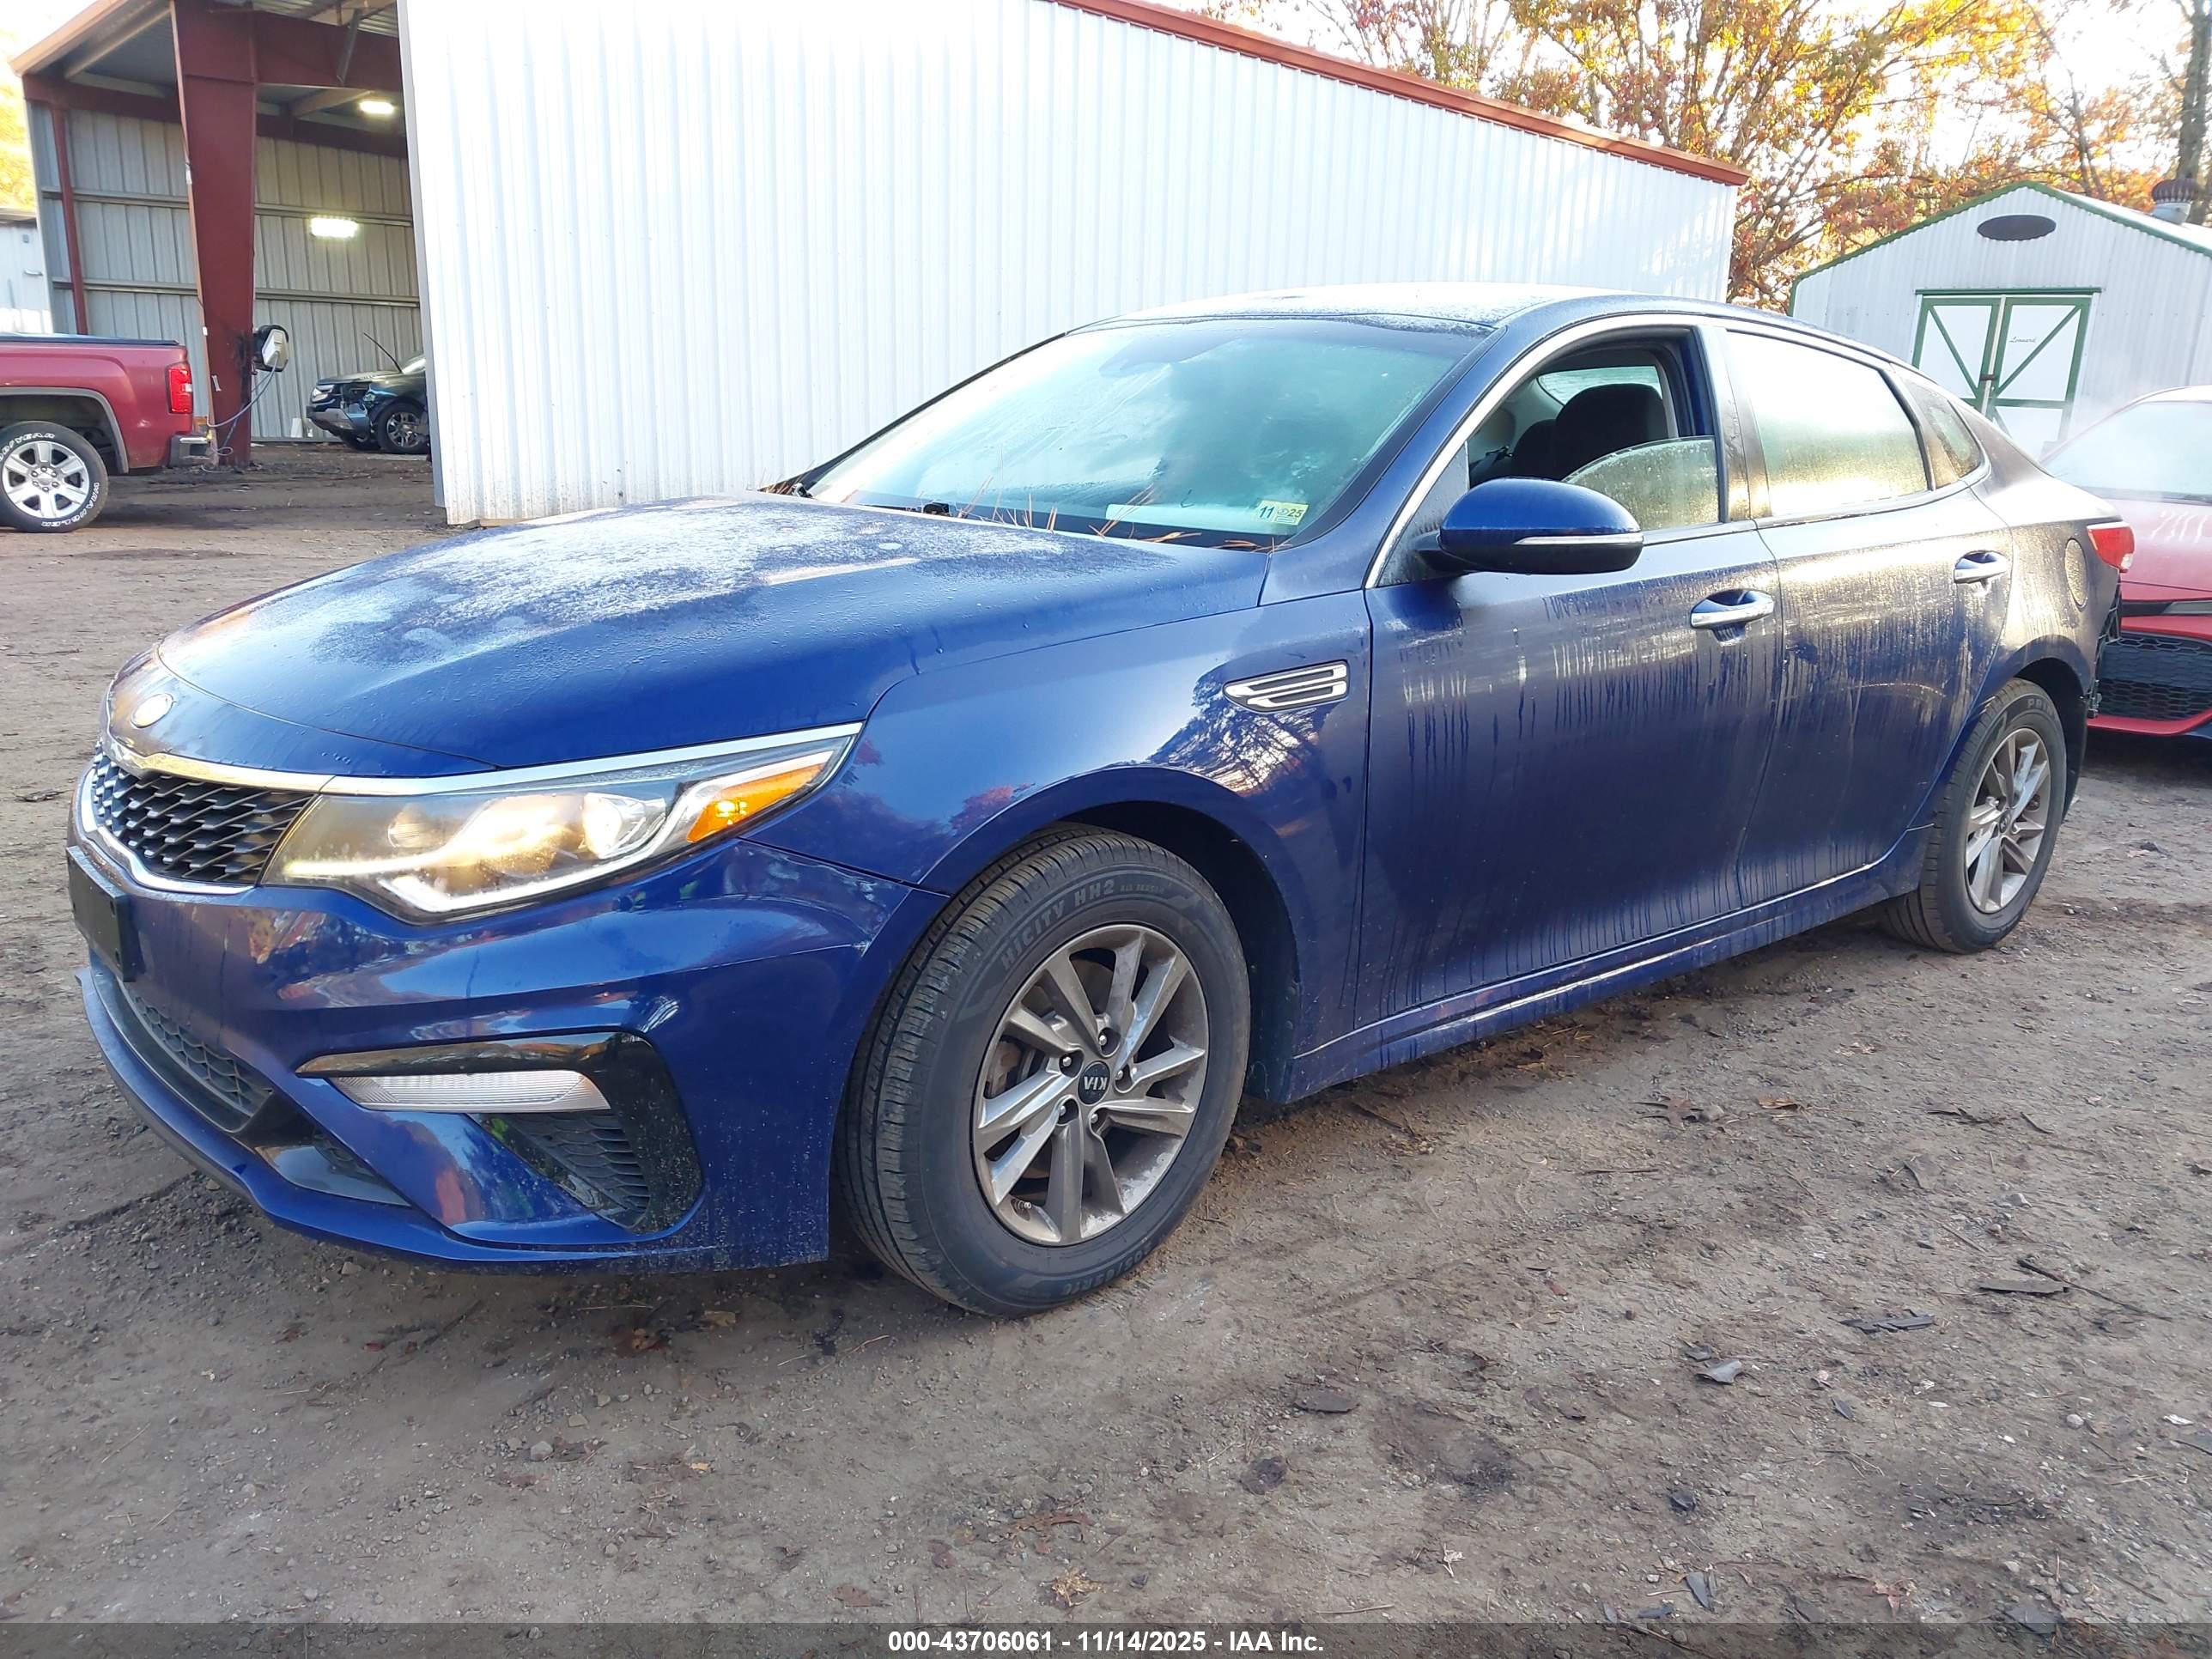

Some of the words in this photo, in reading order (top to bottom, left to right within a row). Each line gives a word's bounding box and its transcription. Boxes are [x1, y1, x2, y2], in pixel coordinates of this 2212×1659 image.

[1260, 506, 1275, 519] 11
[1287, 508, 1304, 518] 25
[1001, 899, 1065, 970] HICITY
[1074, 878, 1115, 907] HH2
[1084, 1076, 1109, 1091] KIA
